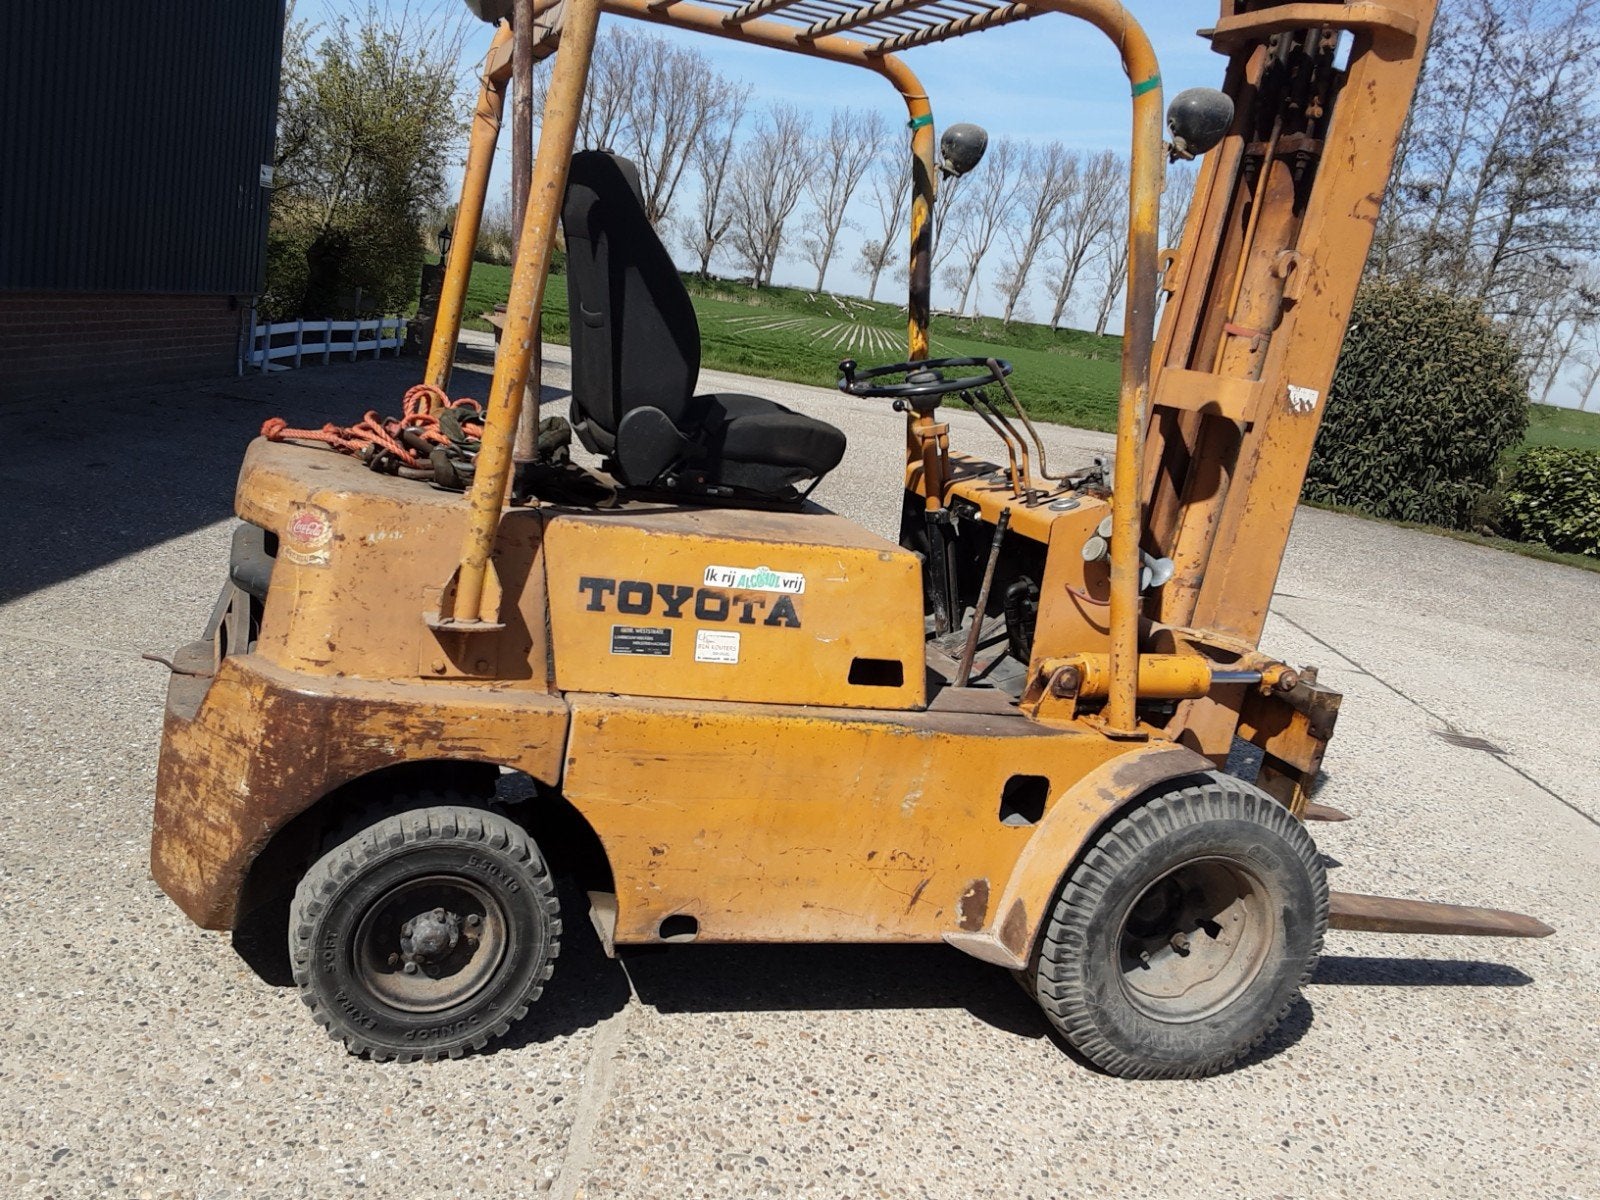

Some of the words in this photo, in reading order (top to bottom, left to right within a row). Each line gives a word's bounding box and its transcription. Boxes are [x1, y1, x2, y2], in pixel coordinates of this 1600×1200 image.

[705, 568, 718, 582] Ik
[721, 570, 737, 587] rij
[783, 576, 804, 593] vrij
[578, 576, 802, 629] TOYOTA
[404, 1013, 481, 1041] DUNLOP
